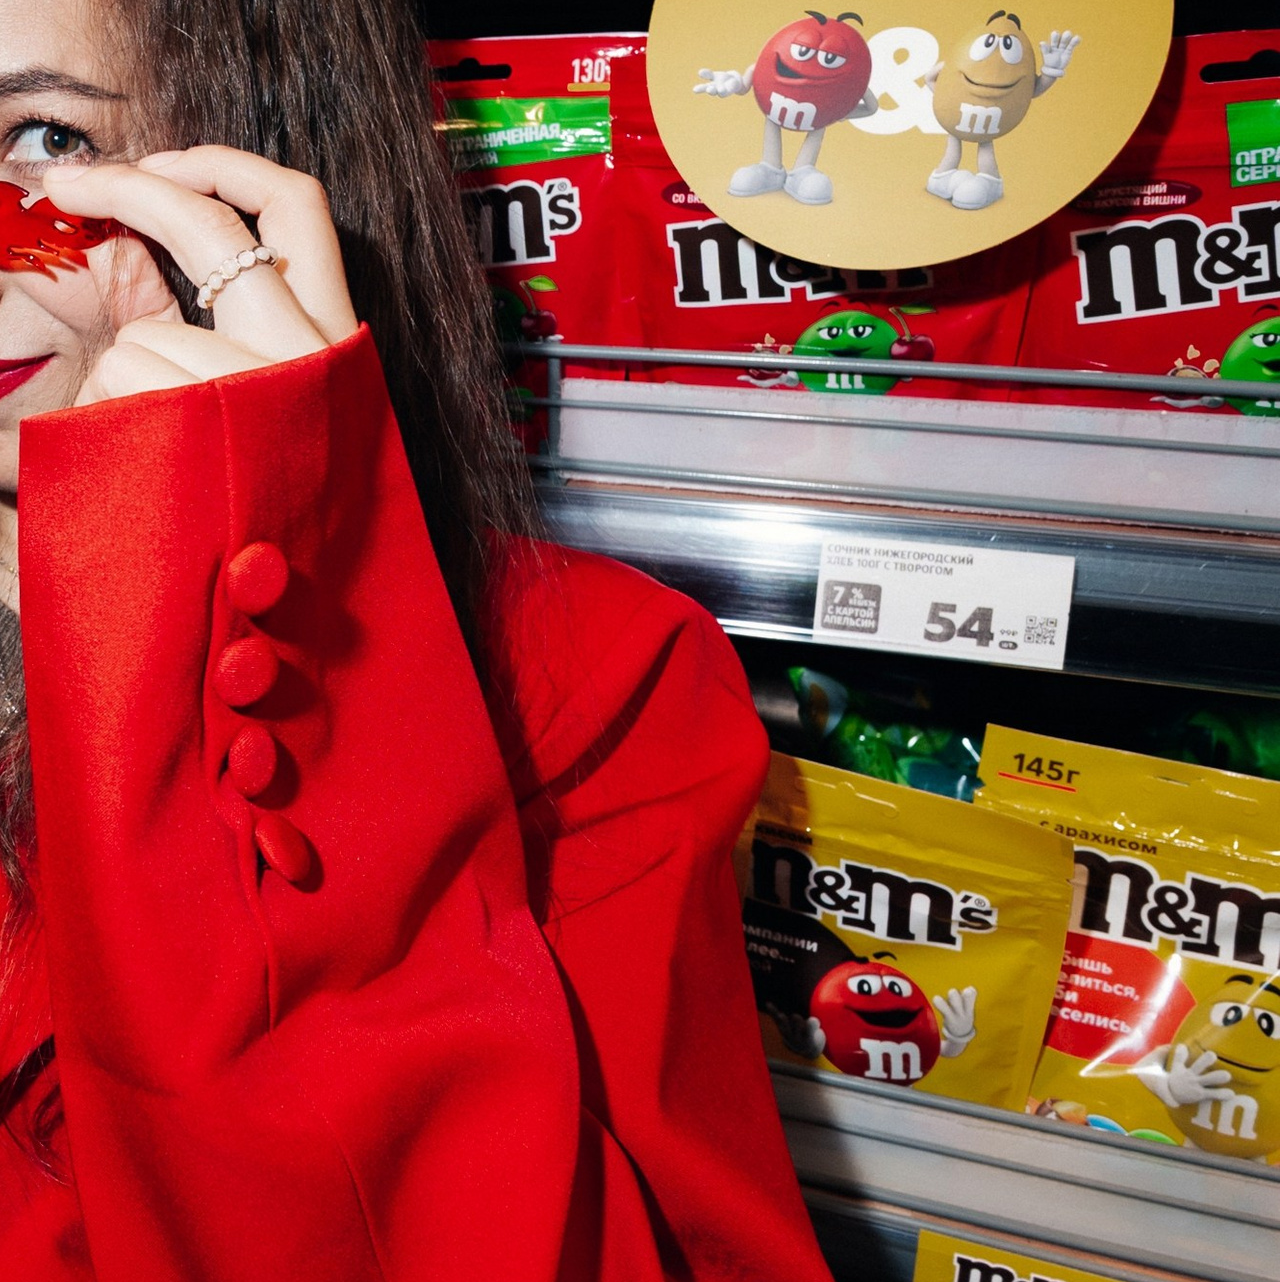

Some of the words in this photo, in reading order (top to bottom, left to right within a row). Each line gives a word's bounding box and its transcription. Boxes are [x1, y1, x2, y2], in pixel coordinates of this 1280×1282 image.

[1142, 195, 1187, 207] ВИШНИ
[826, 555, 853, 567] ХЛЕБ
[893, 562, 954, 577] ТВОРОГОМ
[827, 543, 871, 556] СОЧНИК
[874, 547, 975, 566] НИЖЕГОРОДСКИЙ
[832, 585, 847, 604] 7
[823, 615, 877, 629] АПЕЛЬСИН
[835, 605, 874, 619] КАРТОЙ
[923, 601, 996, 649] 54
[1013, 753, 1081, 785] 145г
[1054, 822, 1159, 856] арахисом
[1067, 843, 1280, 974] m&m
[742, 923, 819, 954] омпании
[1061, 950, 1114, 976] бишь
[1057, 970, 1140, 1002] елиться,
[1049, 1004, 1133, 1036] еселись
